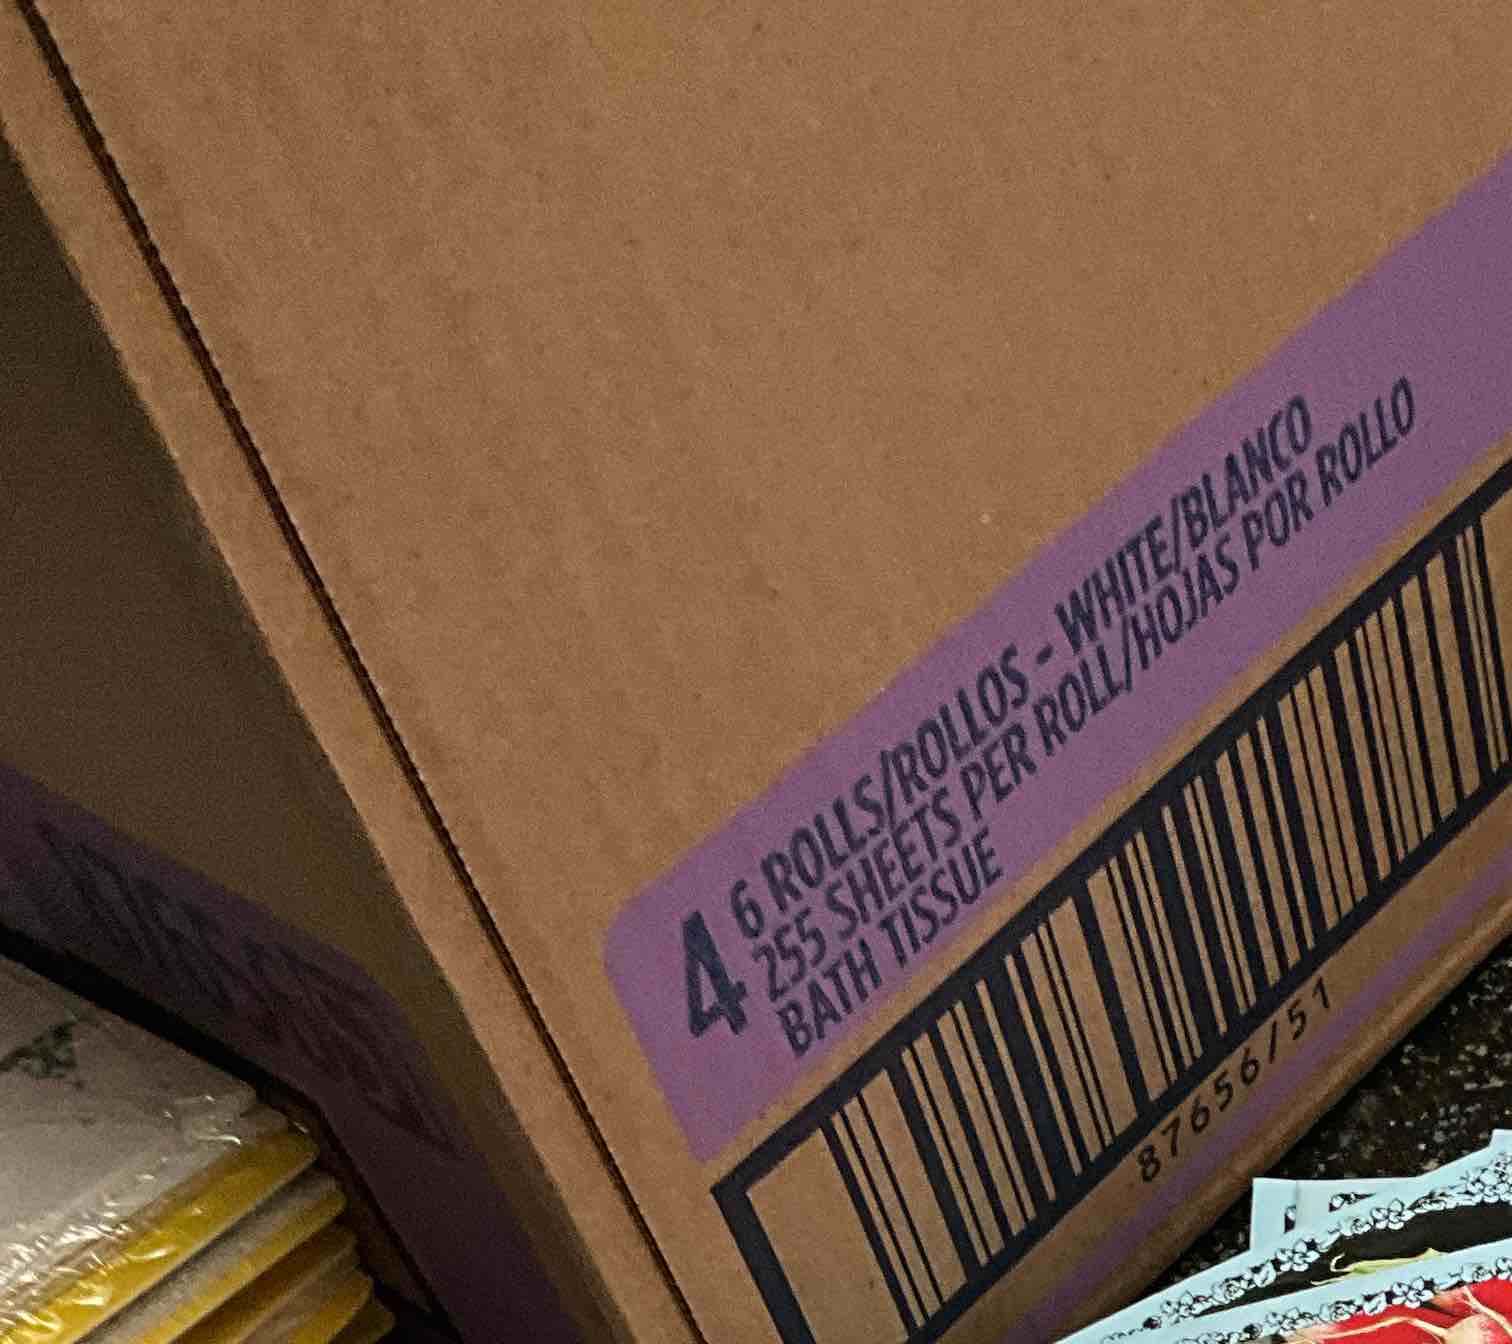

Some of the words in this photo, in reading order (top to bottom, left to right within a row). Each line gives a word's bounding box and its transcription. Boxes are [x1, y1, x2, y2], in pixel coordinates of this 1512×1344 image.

[730, 879, 764, 939] 6
[760, 642, 1029, 913] ROLLS/ROLLOS
[1055, 395, 1312, 655] WHITE/BLANCO
[753, 906, 826, 1002] 255
[826, 786, 961, 941] SHEETS
[960, 722, 1037, 820] PER
[1033, 532, 1240, 756] ROLL/HOJAS
[1242, 471, 1314, 571] POR
[1316, 375, 1416, 506] ROLLO
[682, 909, 747, 1039] 4
[777, 938, 882, 1056] BATH
[879, 828, 1002, 968] TISSUE
[1137, 976, 1329, 1182] 87656/51
